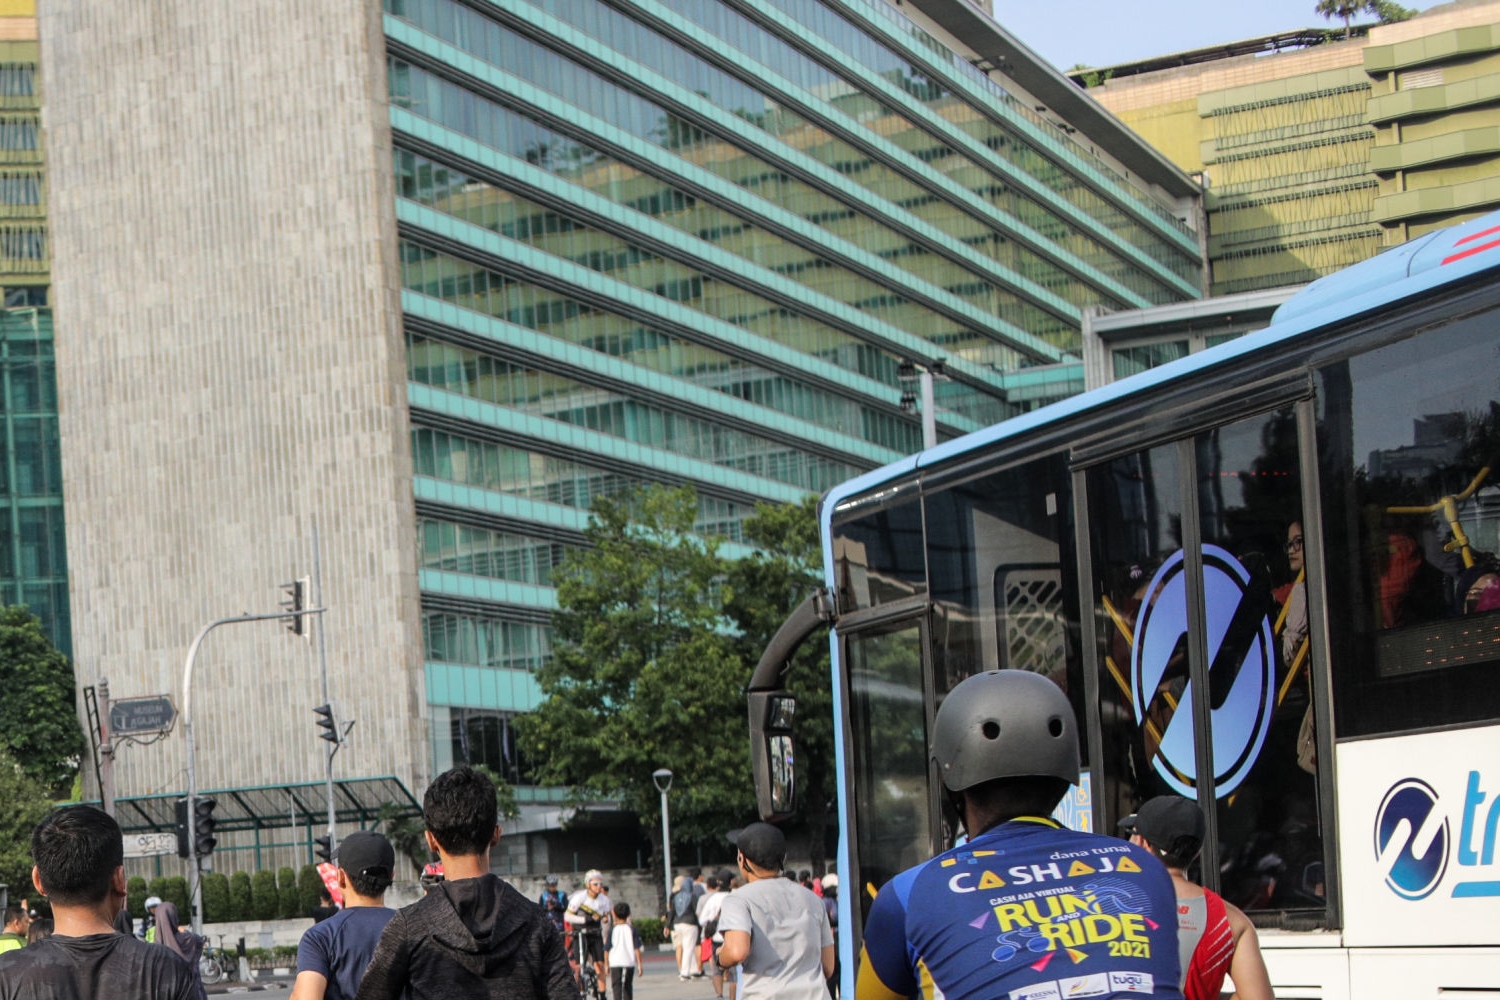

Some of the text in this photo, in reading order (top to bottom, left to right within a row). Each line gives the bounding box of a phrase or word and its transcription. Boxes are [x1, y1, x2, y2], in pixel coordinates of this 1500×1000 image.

[1050, 845, 1131, 861] dana tunai
[989, 885, 1077, 906] CASH AJA VIRTUAL
[993, 889, 1102, 933] RUN
[1056, 911, 1081, 923] AND
[1039, 913, 1150, 951] RIDE
[1107, 940, 1151, 958] 2021
